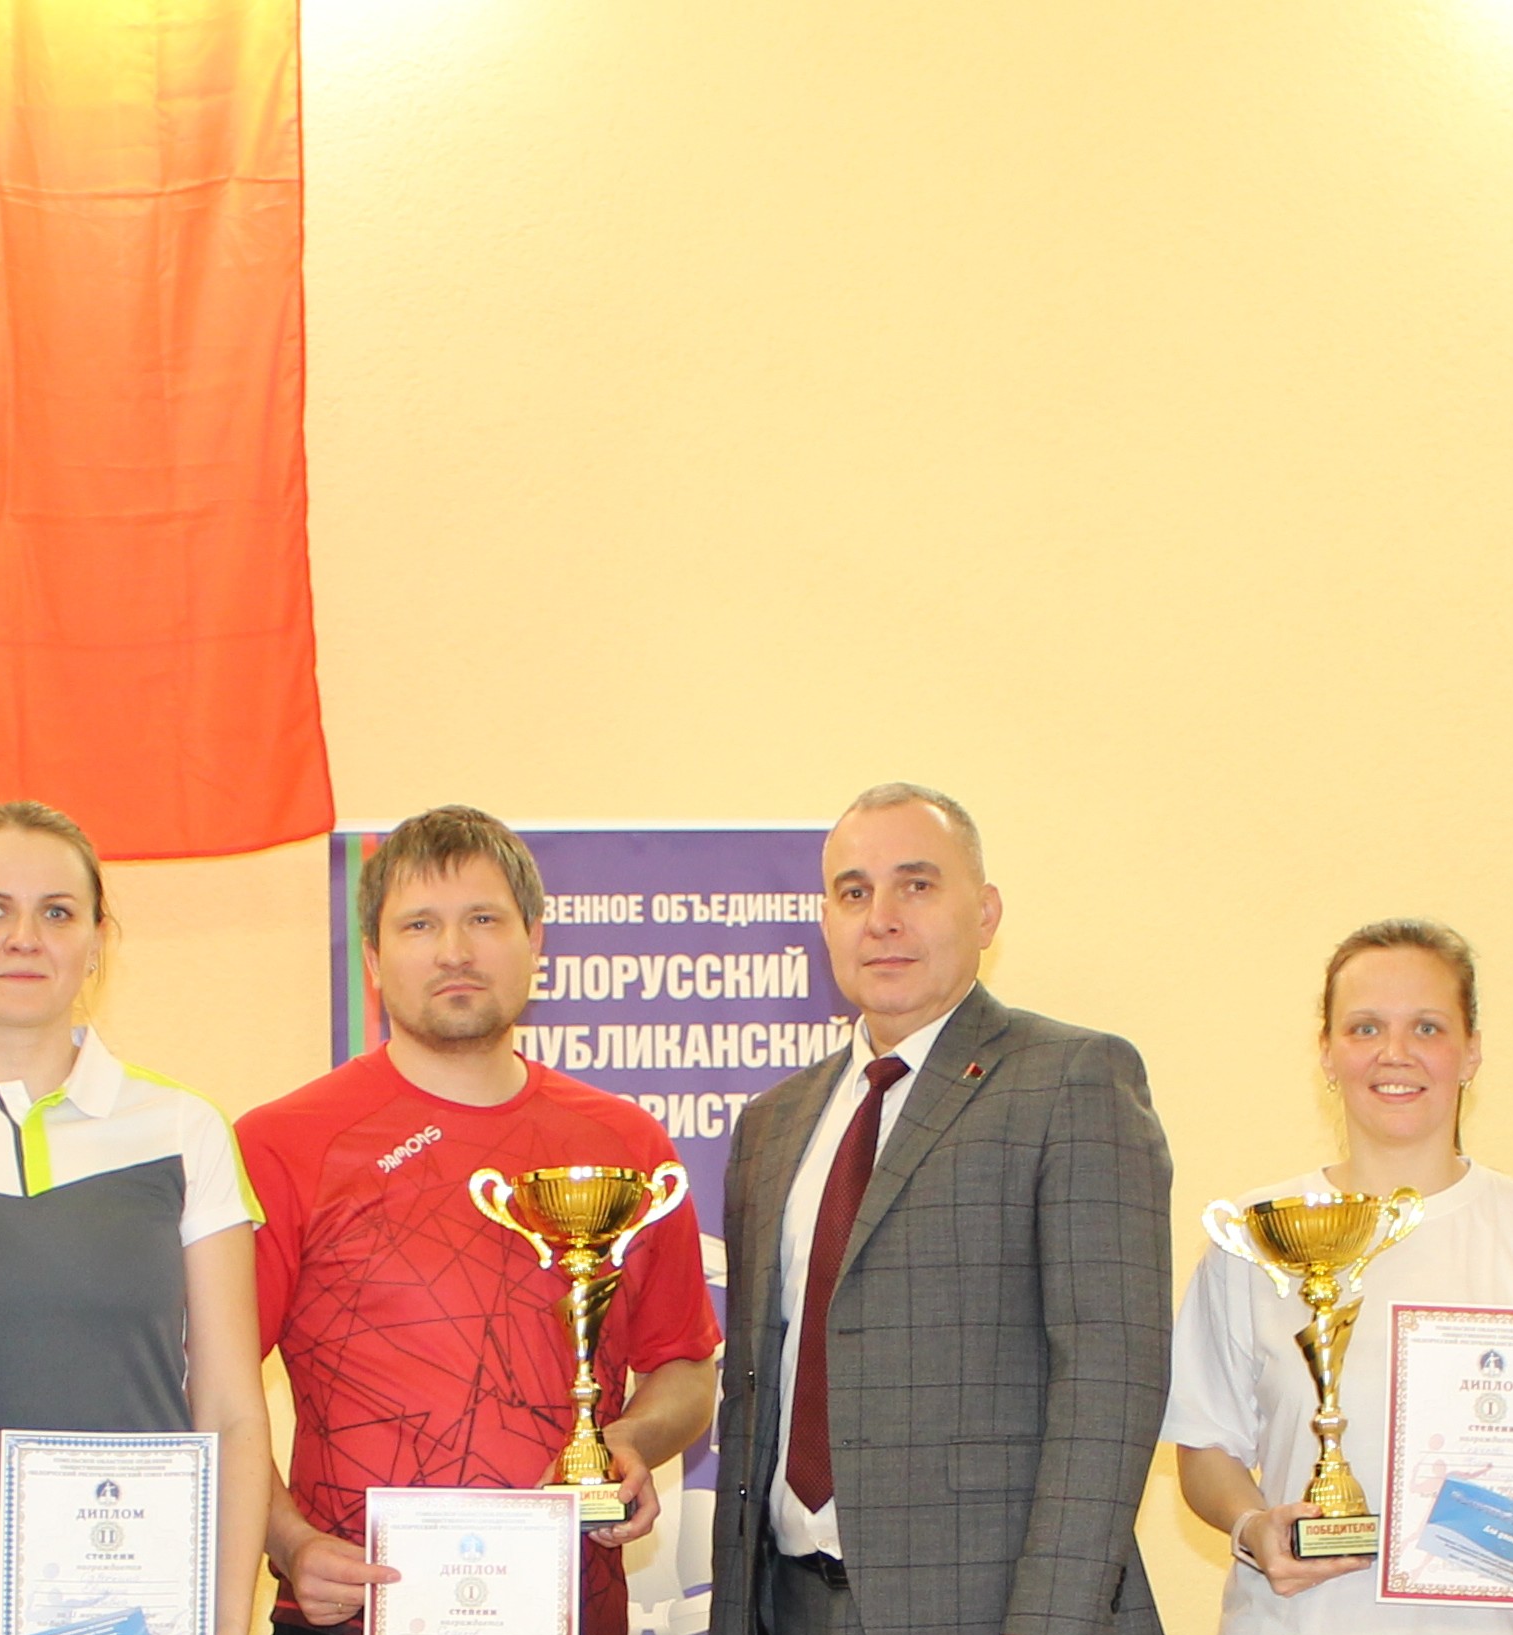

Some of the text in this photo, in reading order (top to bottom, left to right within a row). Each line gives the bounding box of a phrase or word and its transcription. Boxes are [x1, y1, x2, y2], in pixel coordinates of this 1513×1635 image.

[75, 1508, 145, 1520] ДИПЛОМ
[1306, 1522, 1376, 1535] ПОБЕДИТЕЛЮ
[100, 1530, 116, 1544] II
[85, 1552, 135, 1560] степени
[439, 1564, 507, 1577] ДИПЛОМ
[449, 1608, 498, 1616] степени
